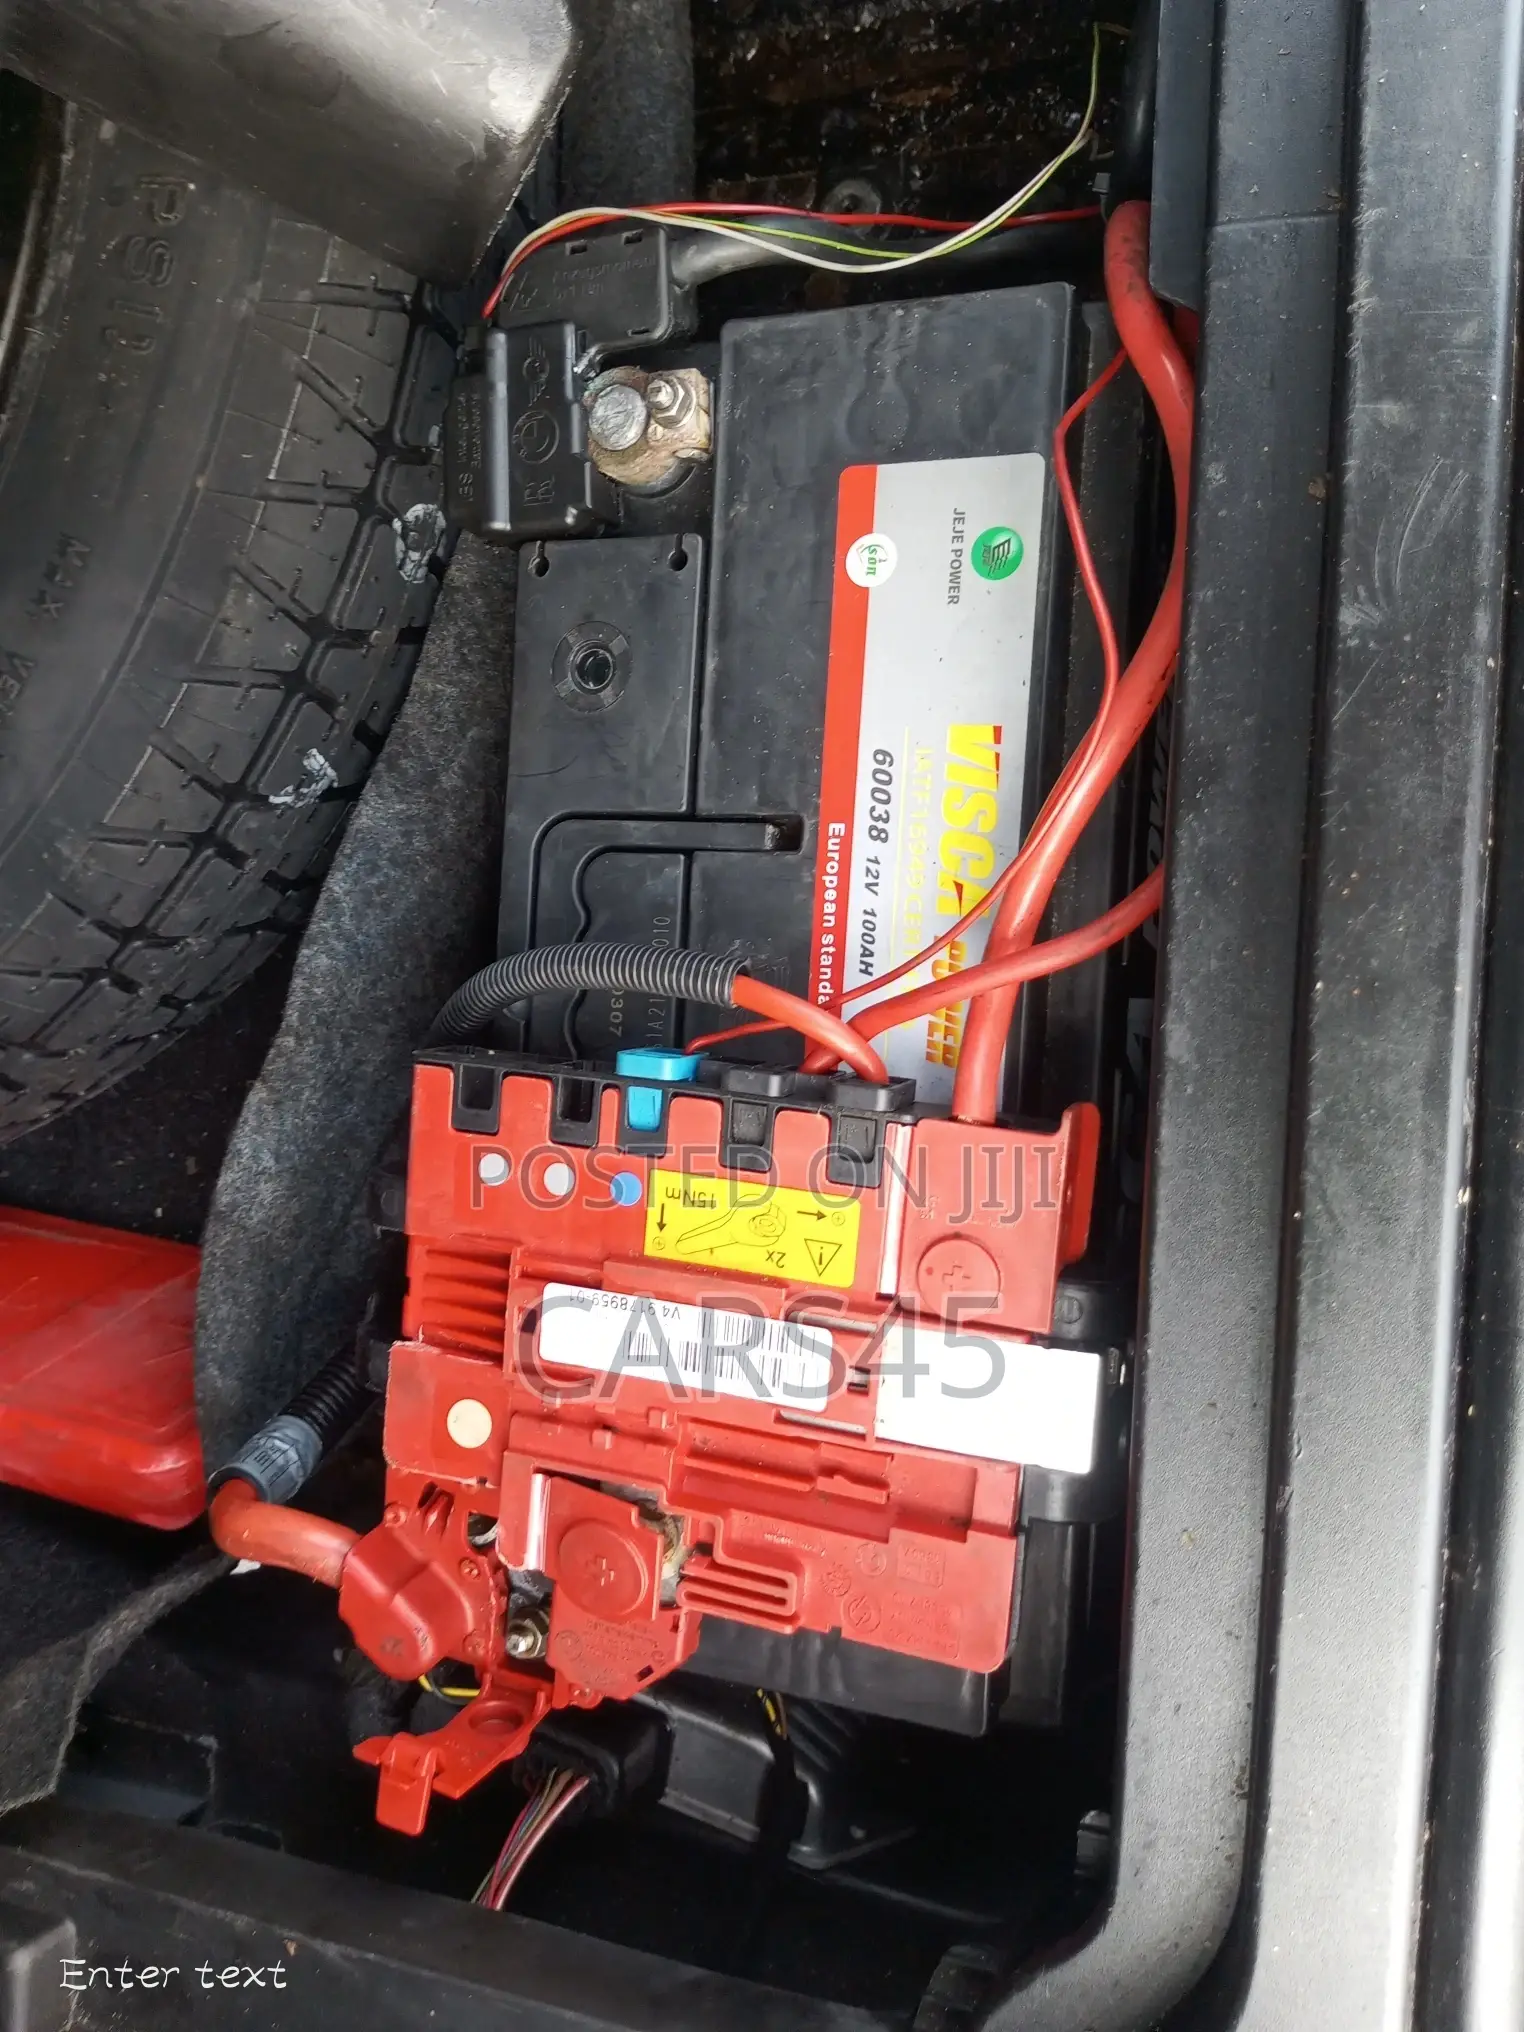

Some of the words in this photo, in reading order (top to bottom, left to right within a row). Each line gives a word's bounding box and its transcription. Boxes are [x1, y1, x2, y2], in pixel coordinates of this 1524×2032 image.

[952, 508, 966, 544] JEJE
[947, 549, 963, 605] POWER
[867, 748, 894, 844] 60038
[936, 723, 1002, 917] VISCA
[821, 822, 846, 928] European
[864, 855, 881, 897] 12V
[817, 933, 837, 1005] standa
[858, 907, 878, 977] 100AH
[665, 1186, 717, 1210] 15Nm
[765, 1249, 787, 1269] 2x
